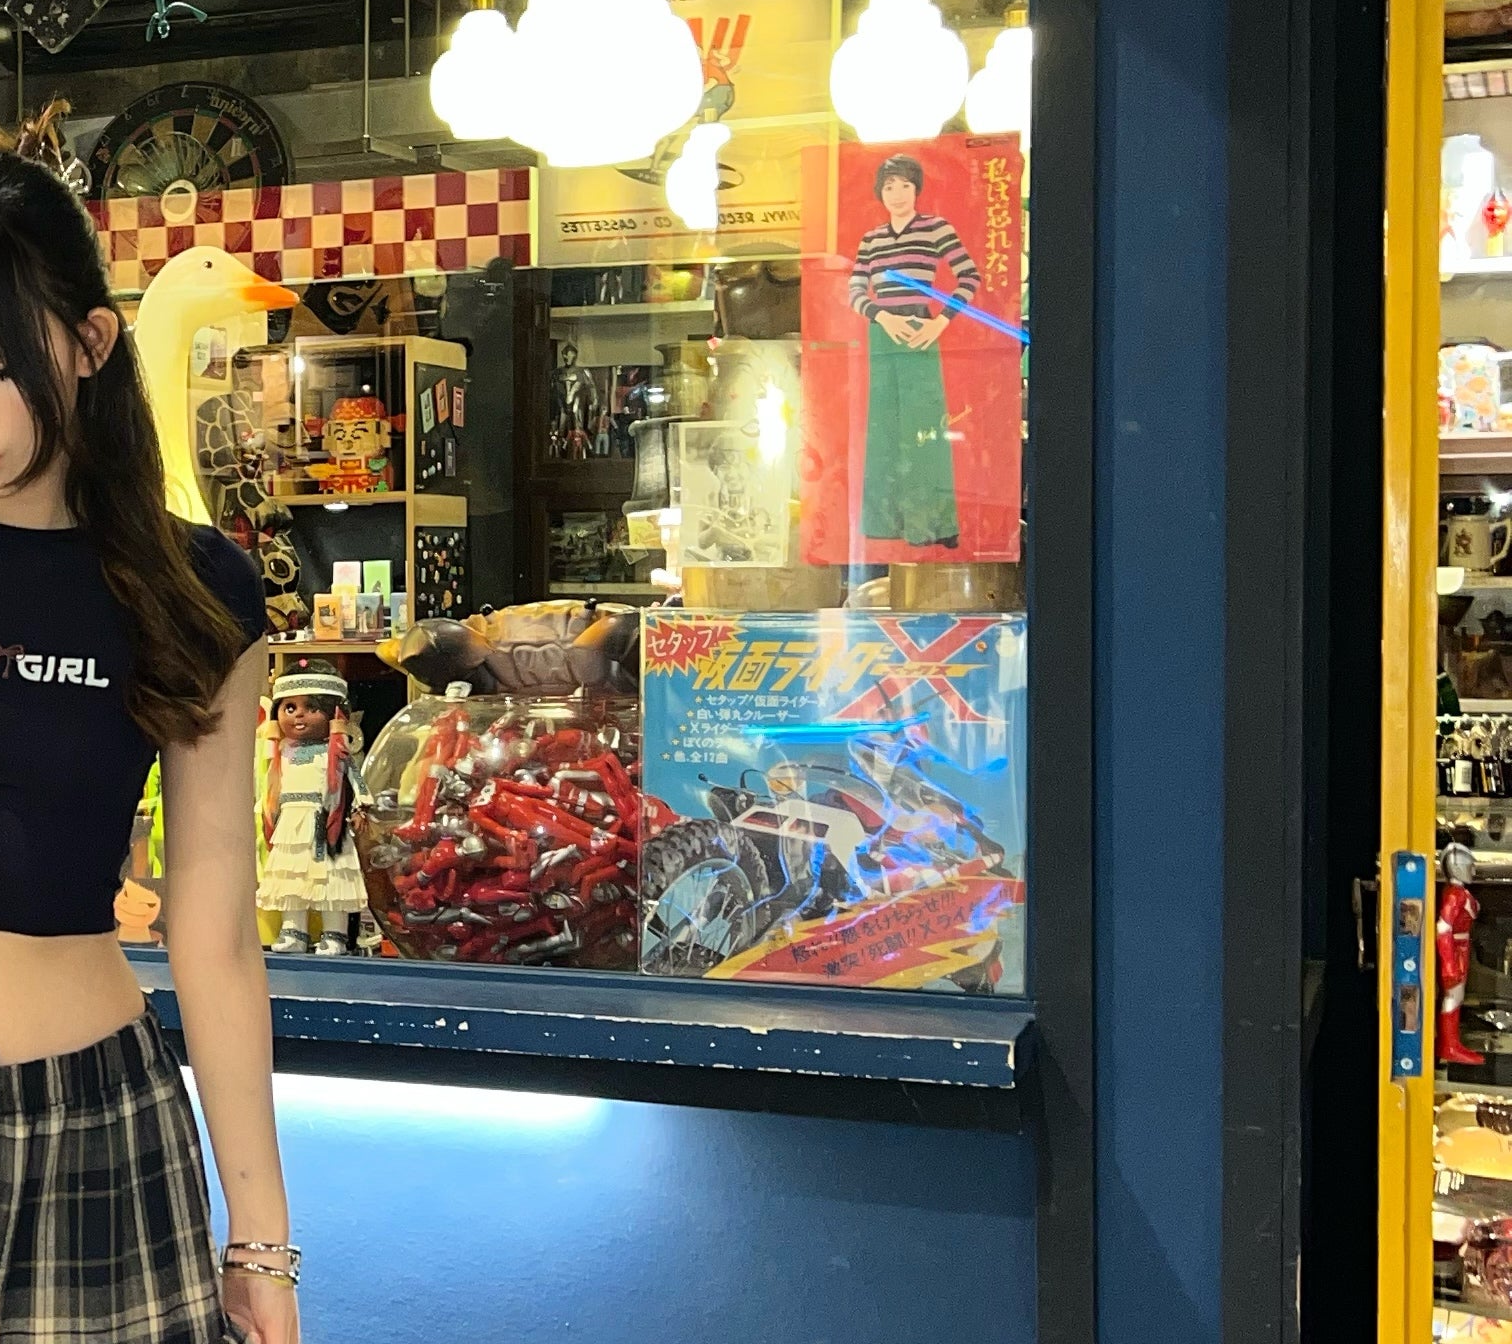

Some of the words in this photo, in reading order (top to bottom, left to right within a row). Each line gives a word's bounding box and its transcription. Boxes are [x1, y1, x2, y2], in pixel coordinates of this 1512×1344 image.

[982, 157, 1012, 292] 私は忘れない
[16, 654, 110, 688] GIRL
